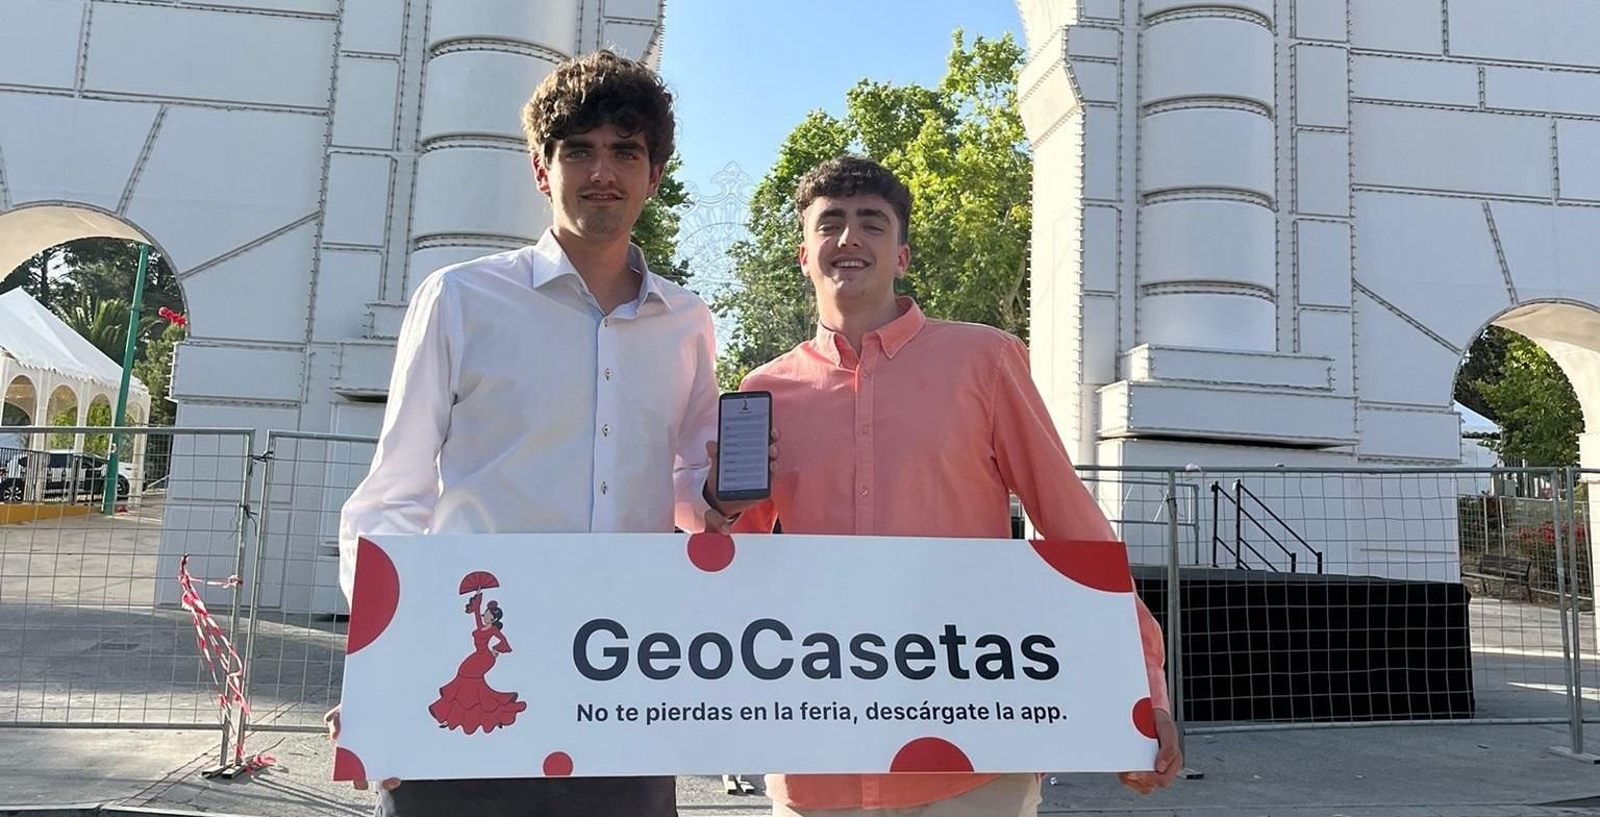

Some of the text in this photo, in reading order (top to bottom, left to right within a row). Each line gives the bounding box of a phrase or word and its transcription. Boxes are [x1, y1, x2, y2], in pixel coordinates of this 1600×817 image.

[572, 618, 1060, 682] GeoCasetas
[576, 700, 1068, 726] No te pierdas en la feria, descárgate la app.
